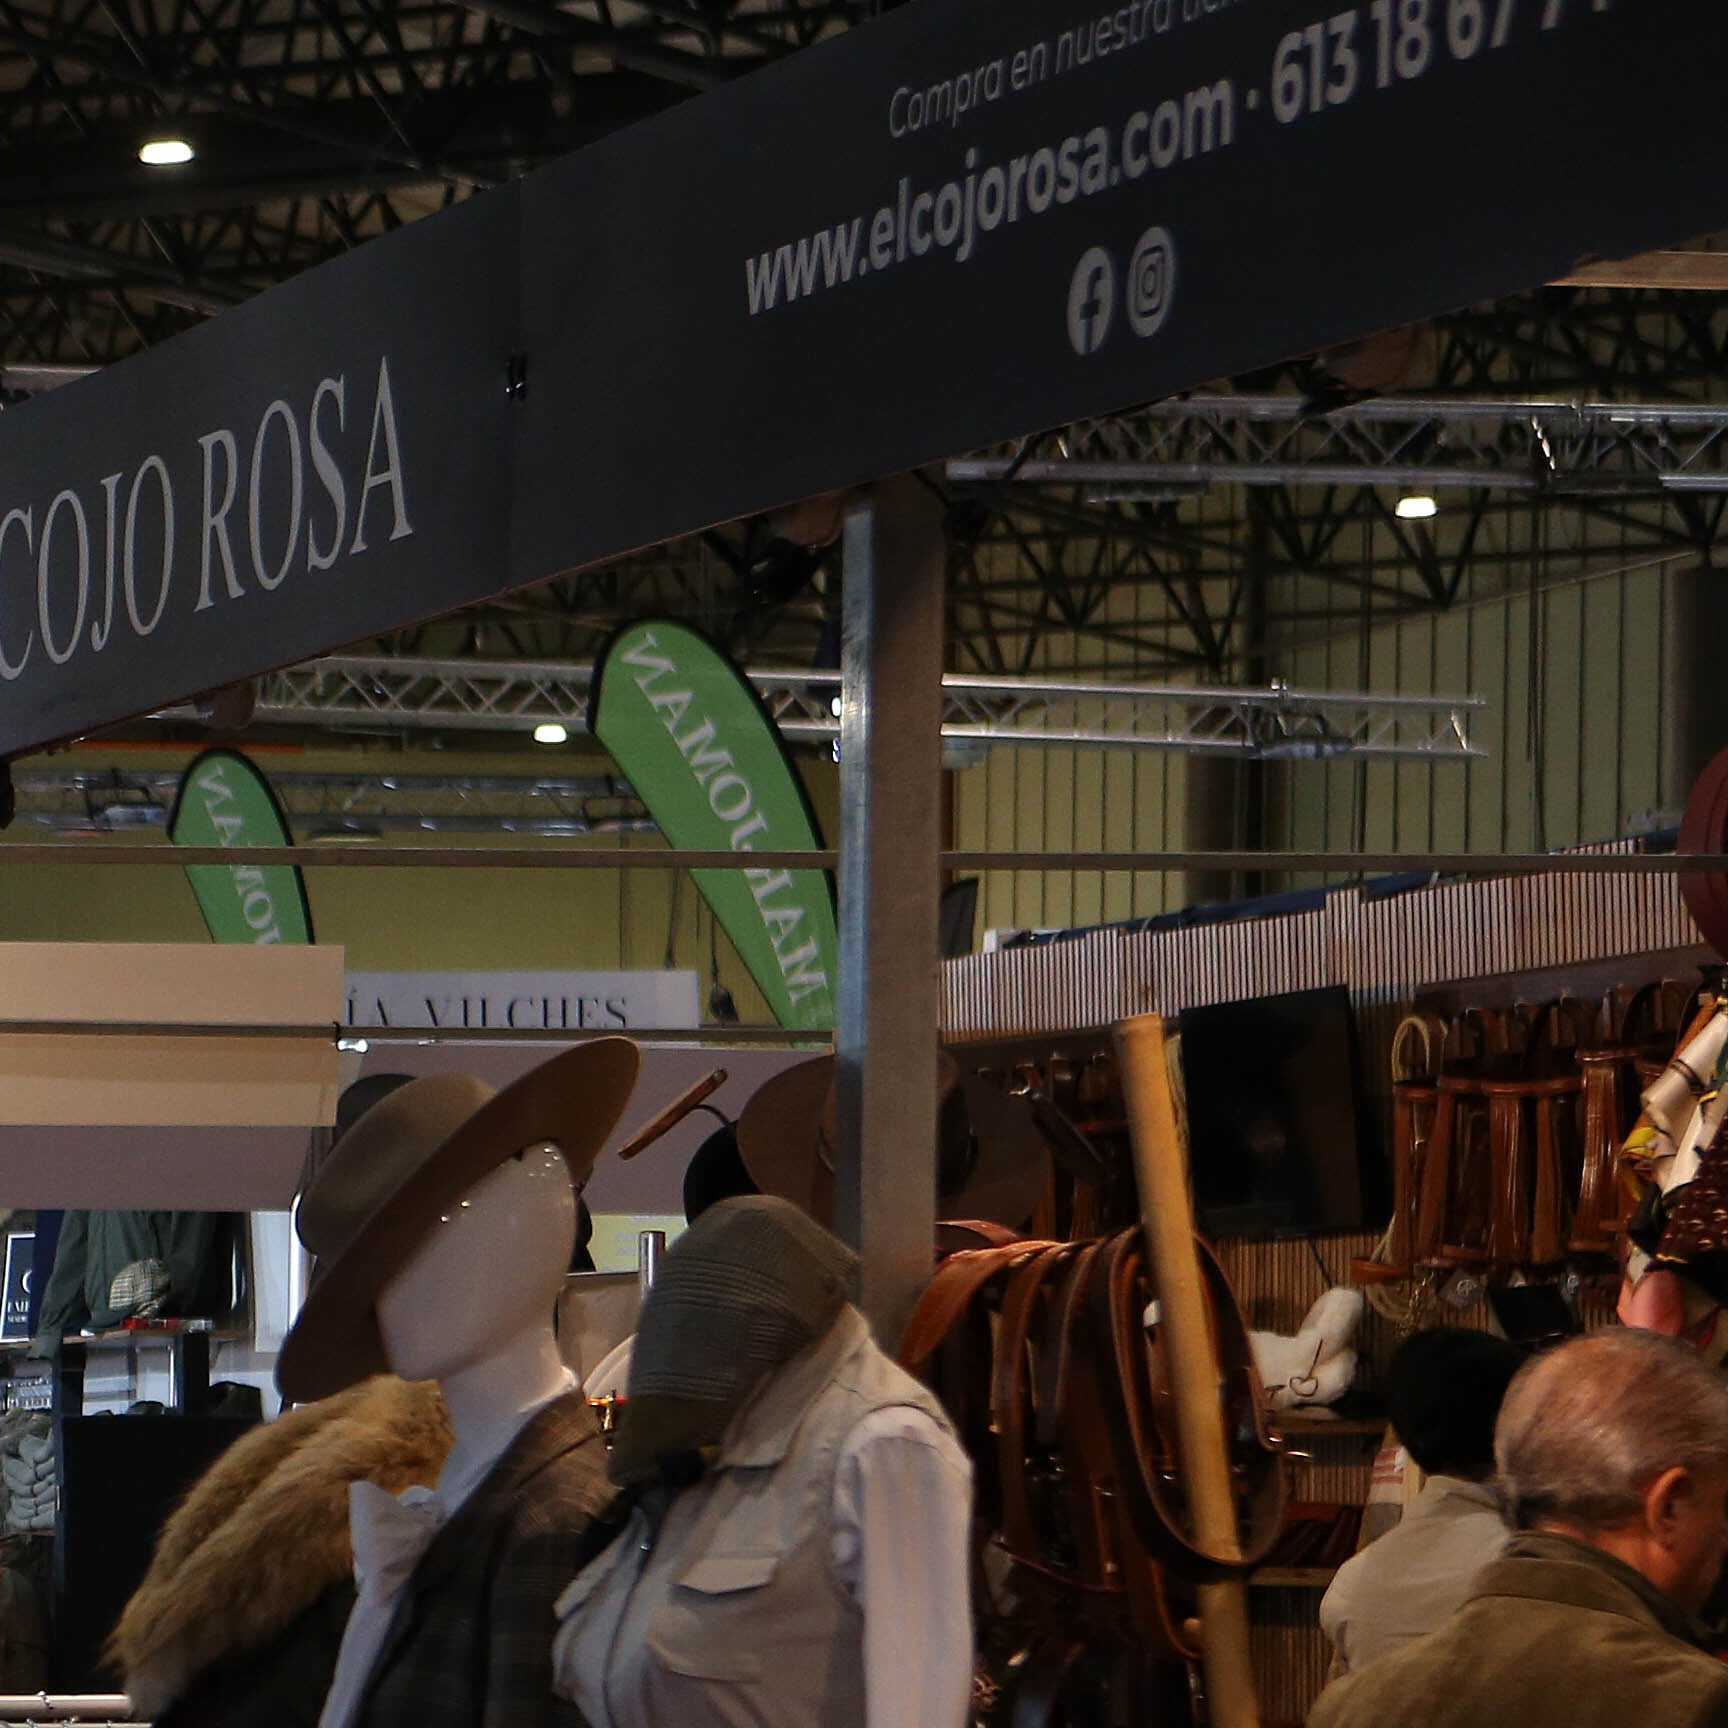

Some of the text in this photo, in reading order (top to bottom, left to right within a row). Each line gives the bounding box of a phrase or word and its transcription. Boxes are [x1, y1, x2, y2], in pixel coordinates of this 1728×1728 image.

[744, 78, 1236, 317] www.elcojorosa.com
[888, 57, 1005, 139] Compra
[1008, 39, 1048, 92] en
[193, 354, 414, 613] ROSA
